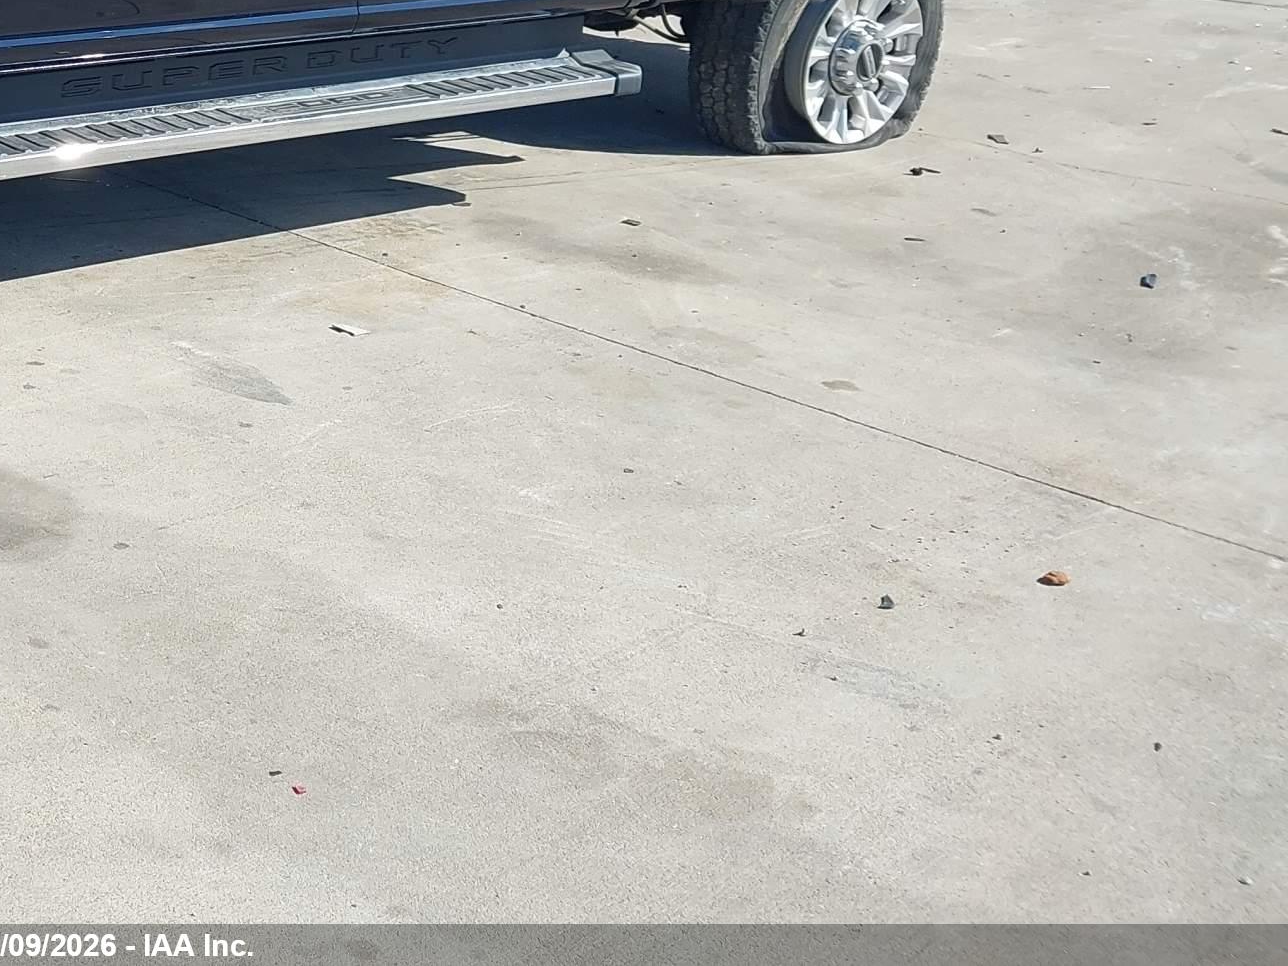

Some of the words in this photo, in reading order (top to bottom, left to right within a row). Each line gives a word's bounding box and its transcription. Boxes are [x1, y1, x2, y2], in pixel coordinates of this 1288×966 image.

[60, 55, 290, 98] SUPER
[307, 36, 459, 70] DUTY
[268, 91, 390, 114] FORD
